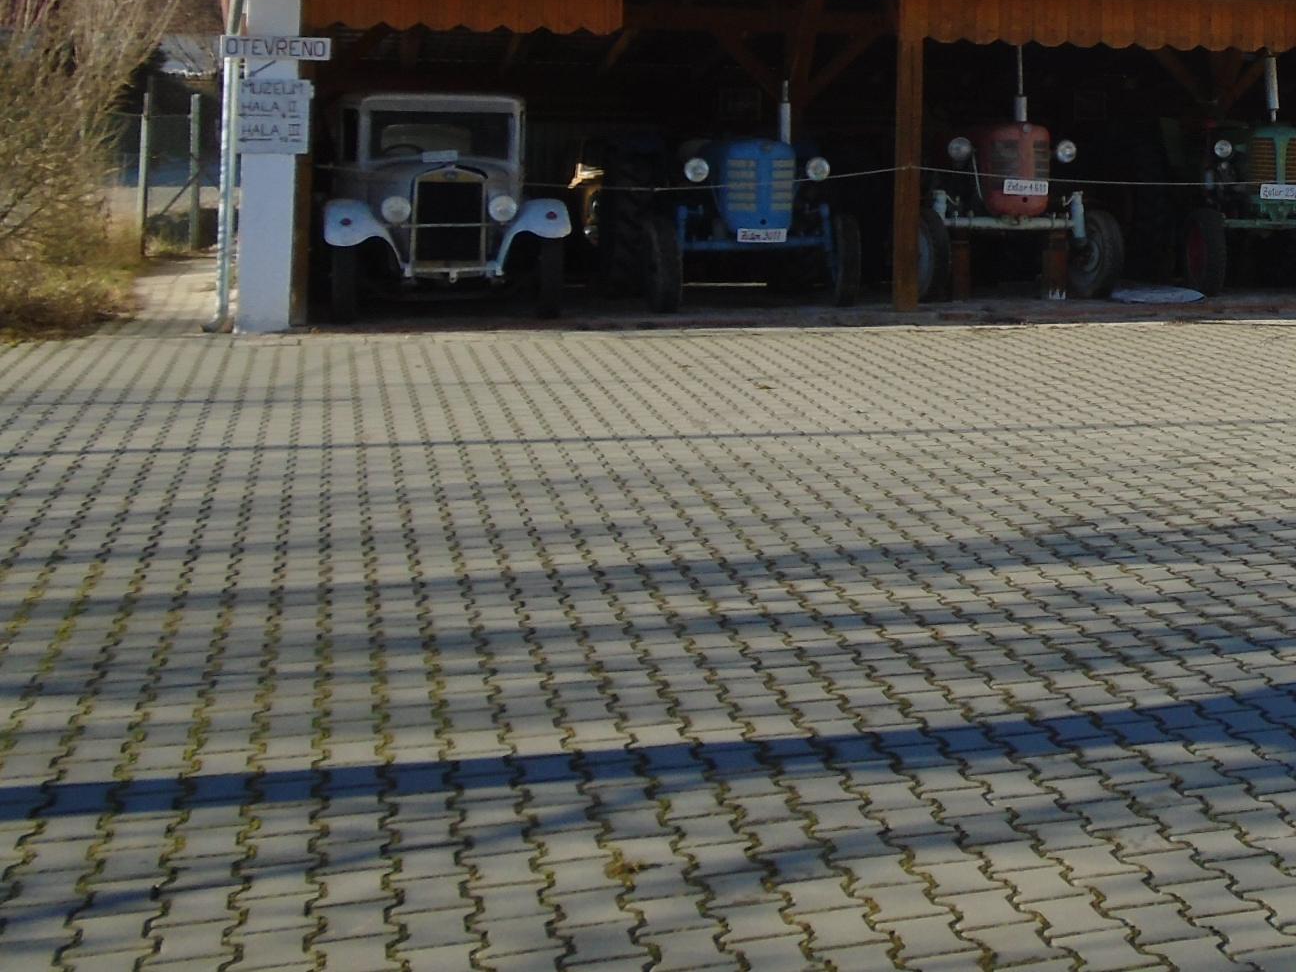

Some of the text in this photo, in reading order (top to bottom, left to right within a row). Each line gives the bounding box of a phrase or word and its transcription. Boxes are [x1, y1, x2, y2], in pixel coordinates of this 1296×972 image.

[241, 80, 304, 96] MUZEUM
[241, 101, 280, 113] HALA
[241, 123, 280, 136] HALA
